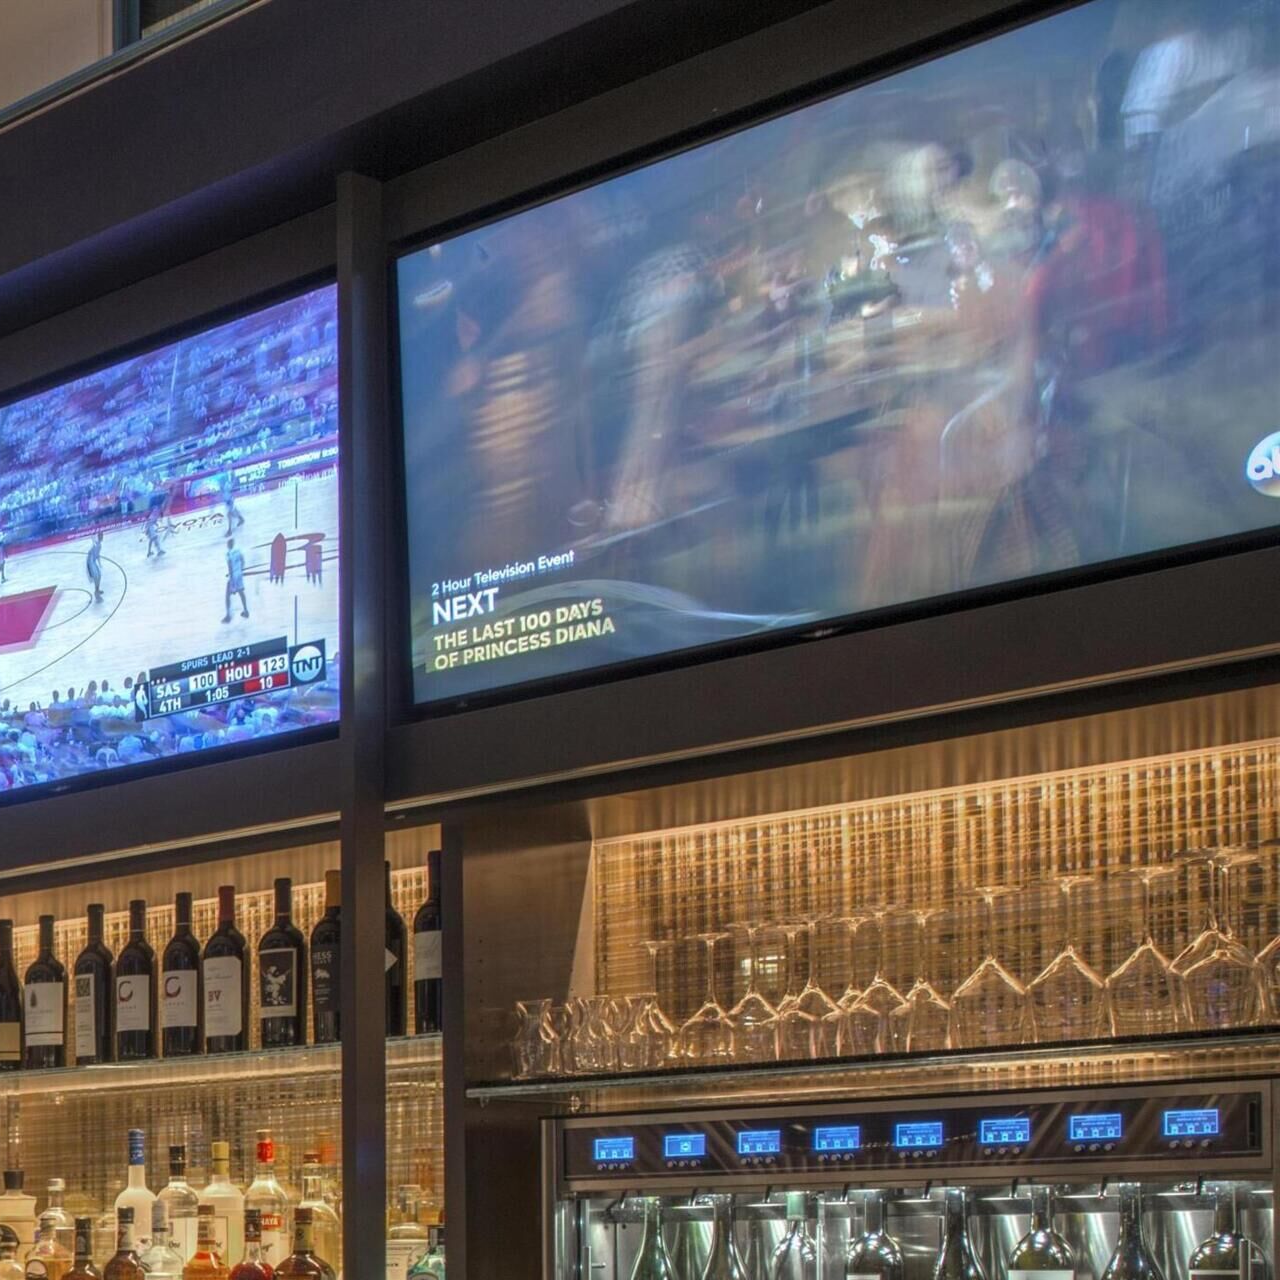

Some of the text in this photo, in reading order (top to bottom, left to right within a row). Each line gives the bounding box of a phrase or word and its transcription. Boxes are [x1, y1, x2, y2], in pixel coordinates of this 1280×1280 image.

[432, 549, 575, 596] 2 Hour Television Event
[432, 588, 500, 625] NEXT
[434, 597, 604, 652] THE LAST 100 DAYS
[180, 647, 251, 673] SPURS LEAD 2-1
[434, 616, 615, 671] OF PRINCESS DIANA
[156, 656, 286, 699] SAS 100 HOU 123
[292, 655, 324, 674] TNT
[158, 677, 274, 713] 4TH 1:05 10
[207, 990, 222, 1003] BV
